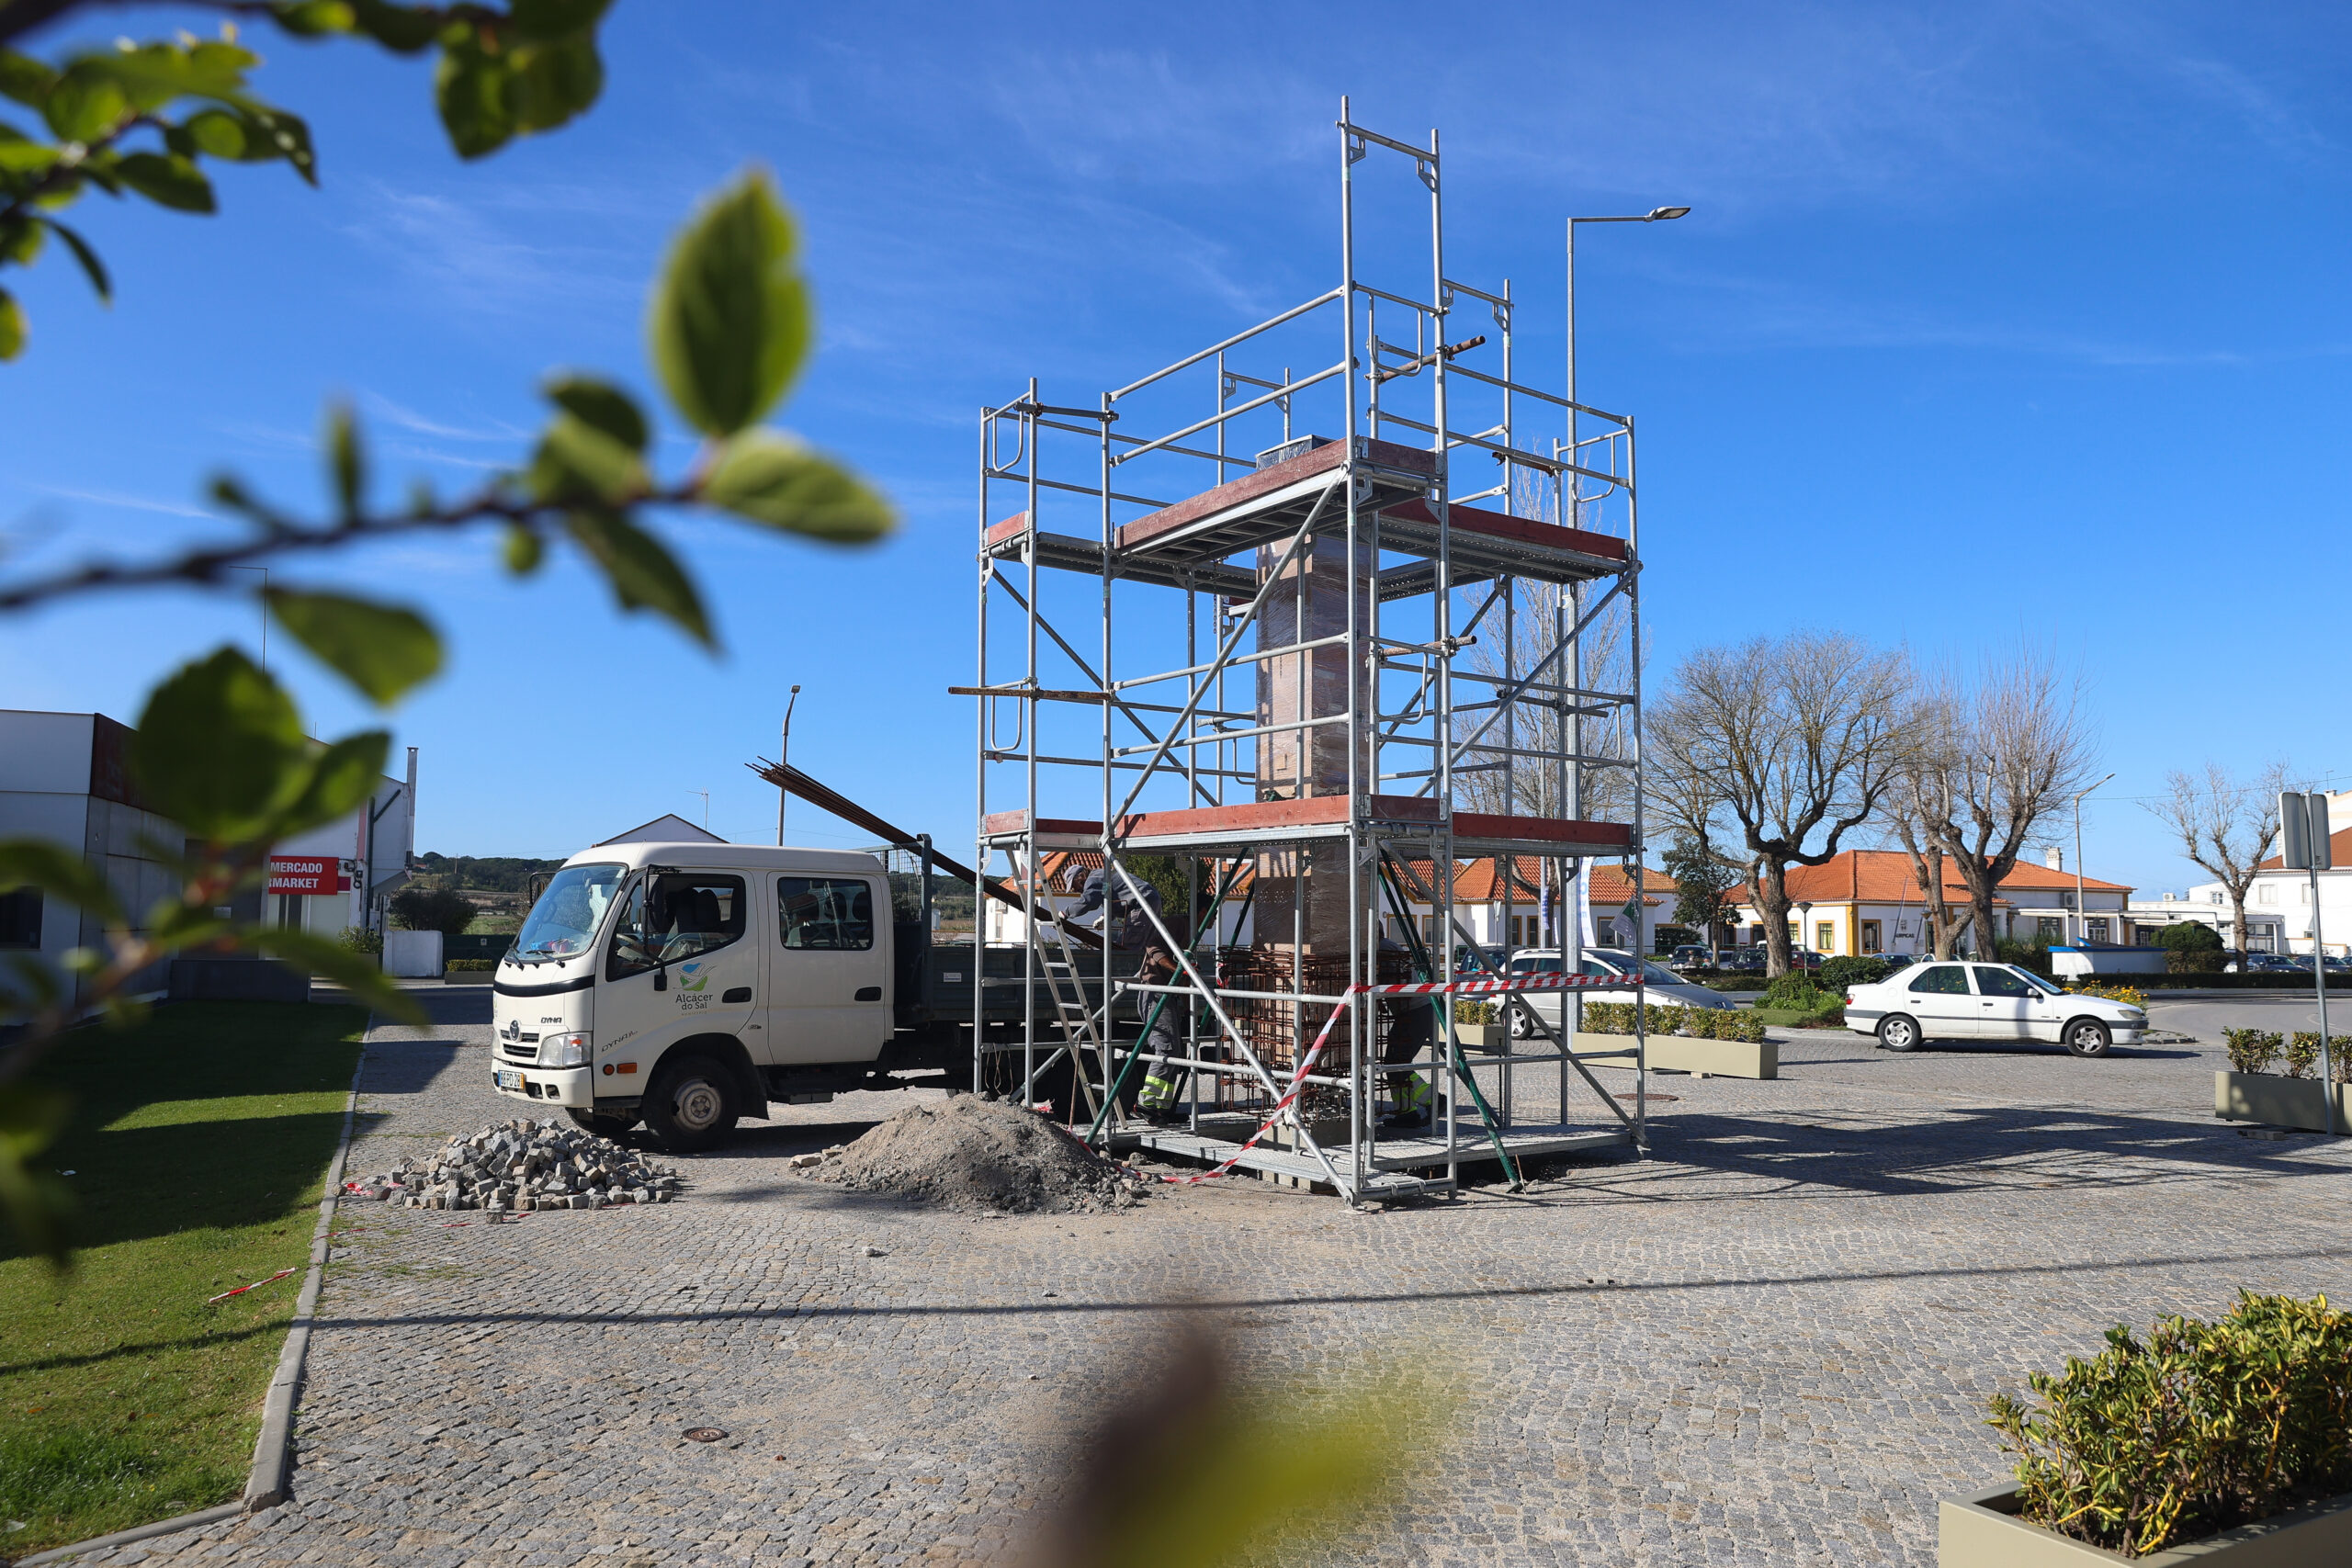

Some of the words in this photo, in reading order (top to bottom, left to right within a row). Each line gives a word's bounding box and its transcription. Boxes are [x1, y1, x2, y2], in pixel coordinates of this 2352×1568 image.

[675, 993, 713, 1003] Alcácer
[681, 1002, 693, 1010] do
[695, 1001, 707, 1010] Sal
